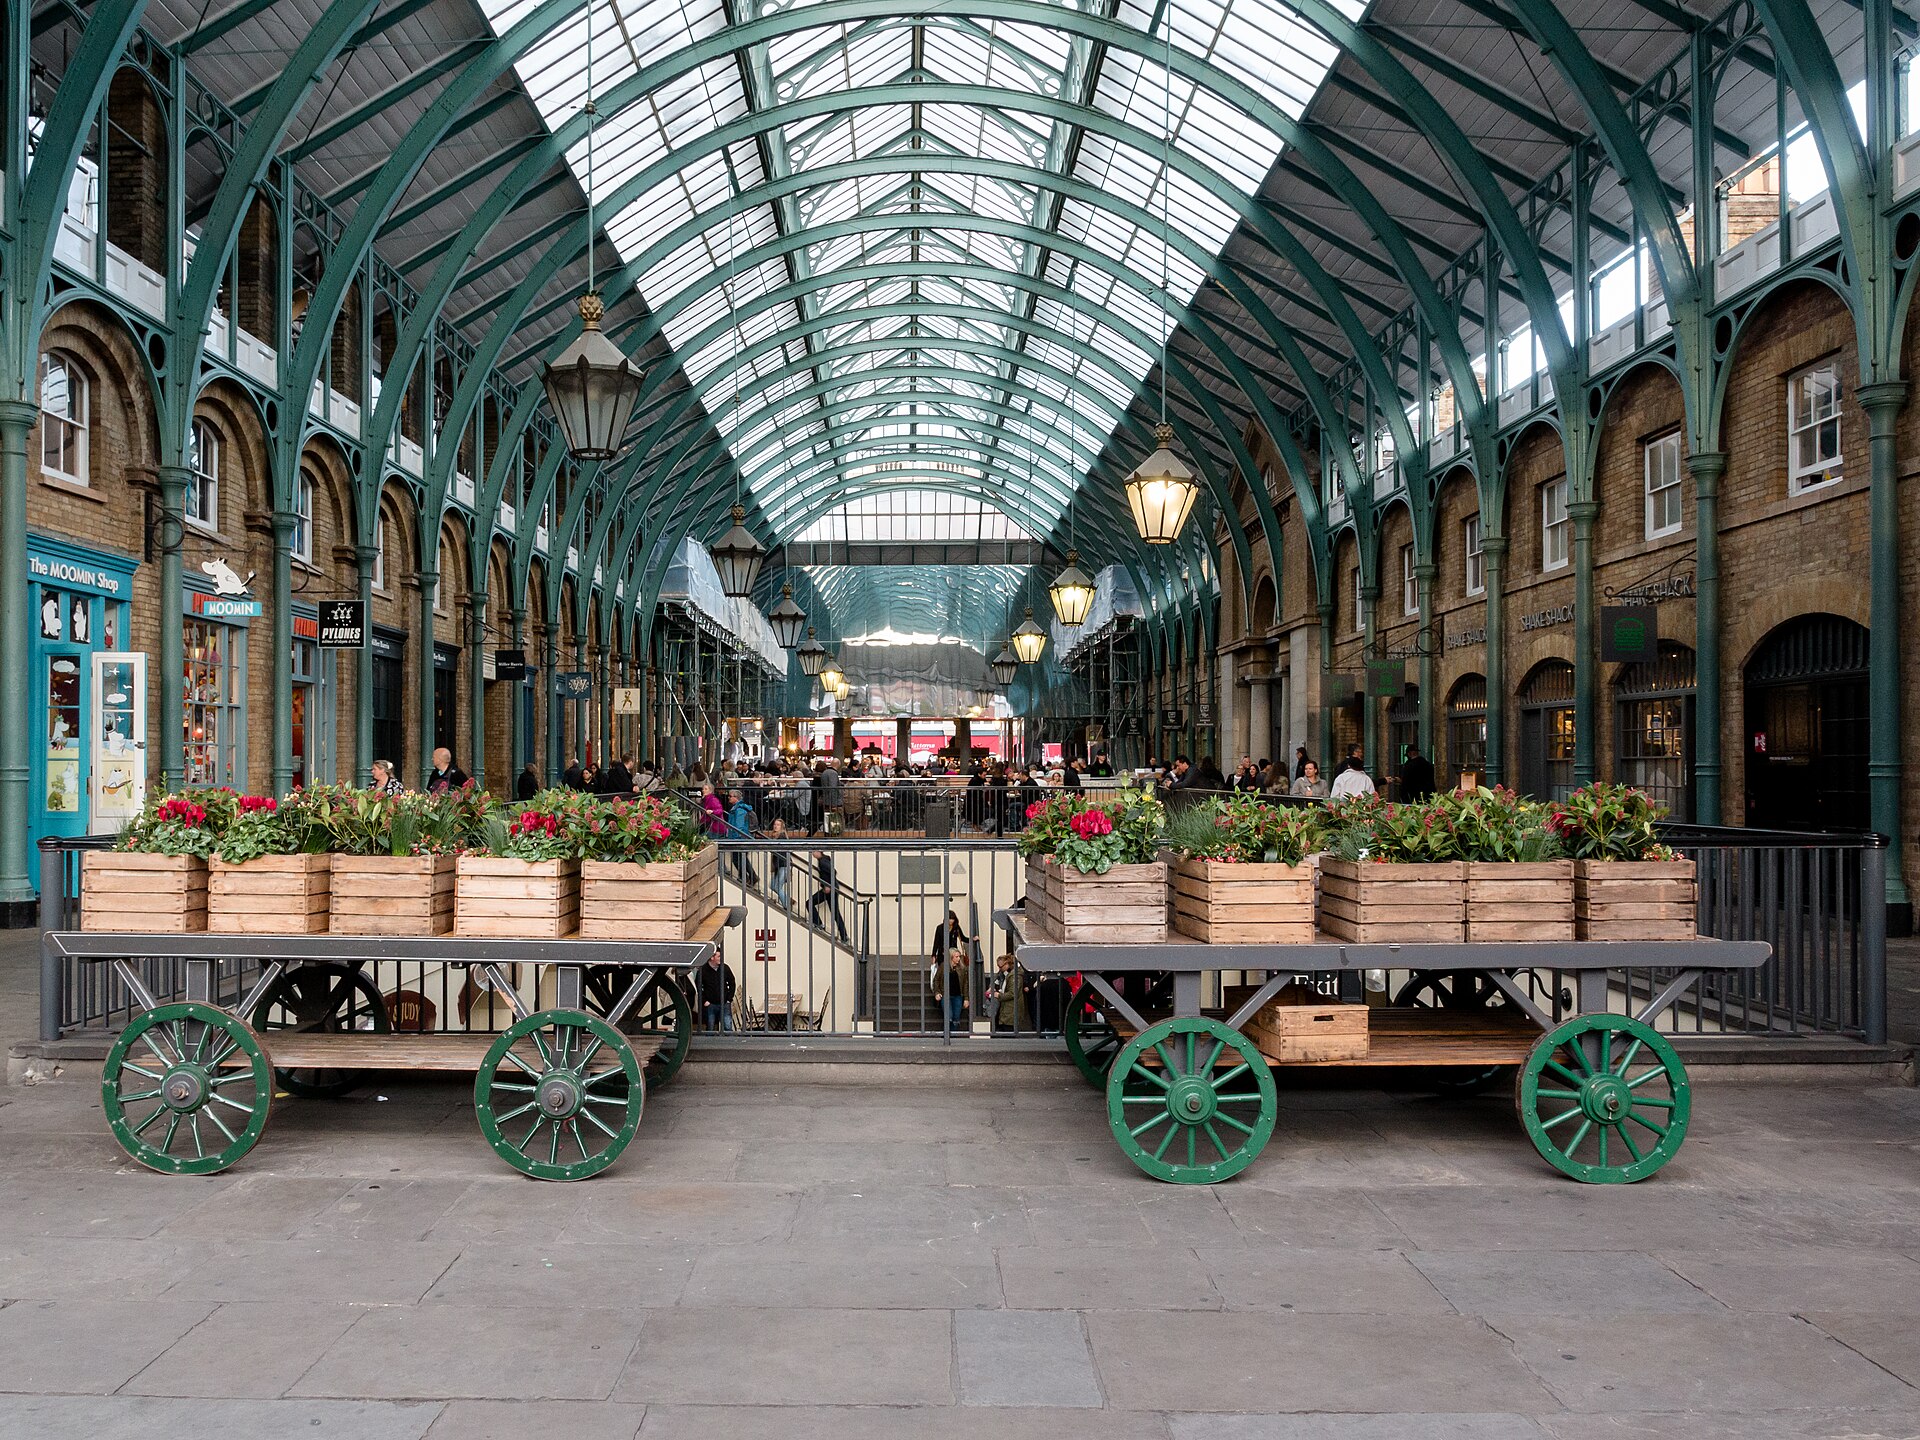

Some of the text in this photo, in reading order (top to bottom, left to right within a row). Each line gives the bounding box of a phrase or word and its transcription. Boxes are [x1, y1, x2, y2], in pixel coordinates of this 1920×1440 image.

[30, 557, 119, 594] The MOOMIN Shop
[208, 602, 254, 615] MOOMIN
[1520, 604, 1574, 631] SHAKE SHACK
[322, 627, 361, 640] PYLONES
[400, 1002, 421, 1024] JUDY
